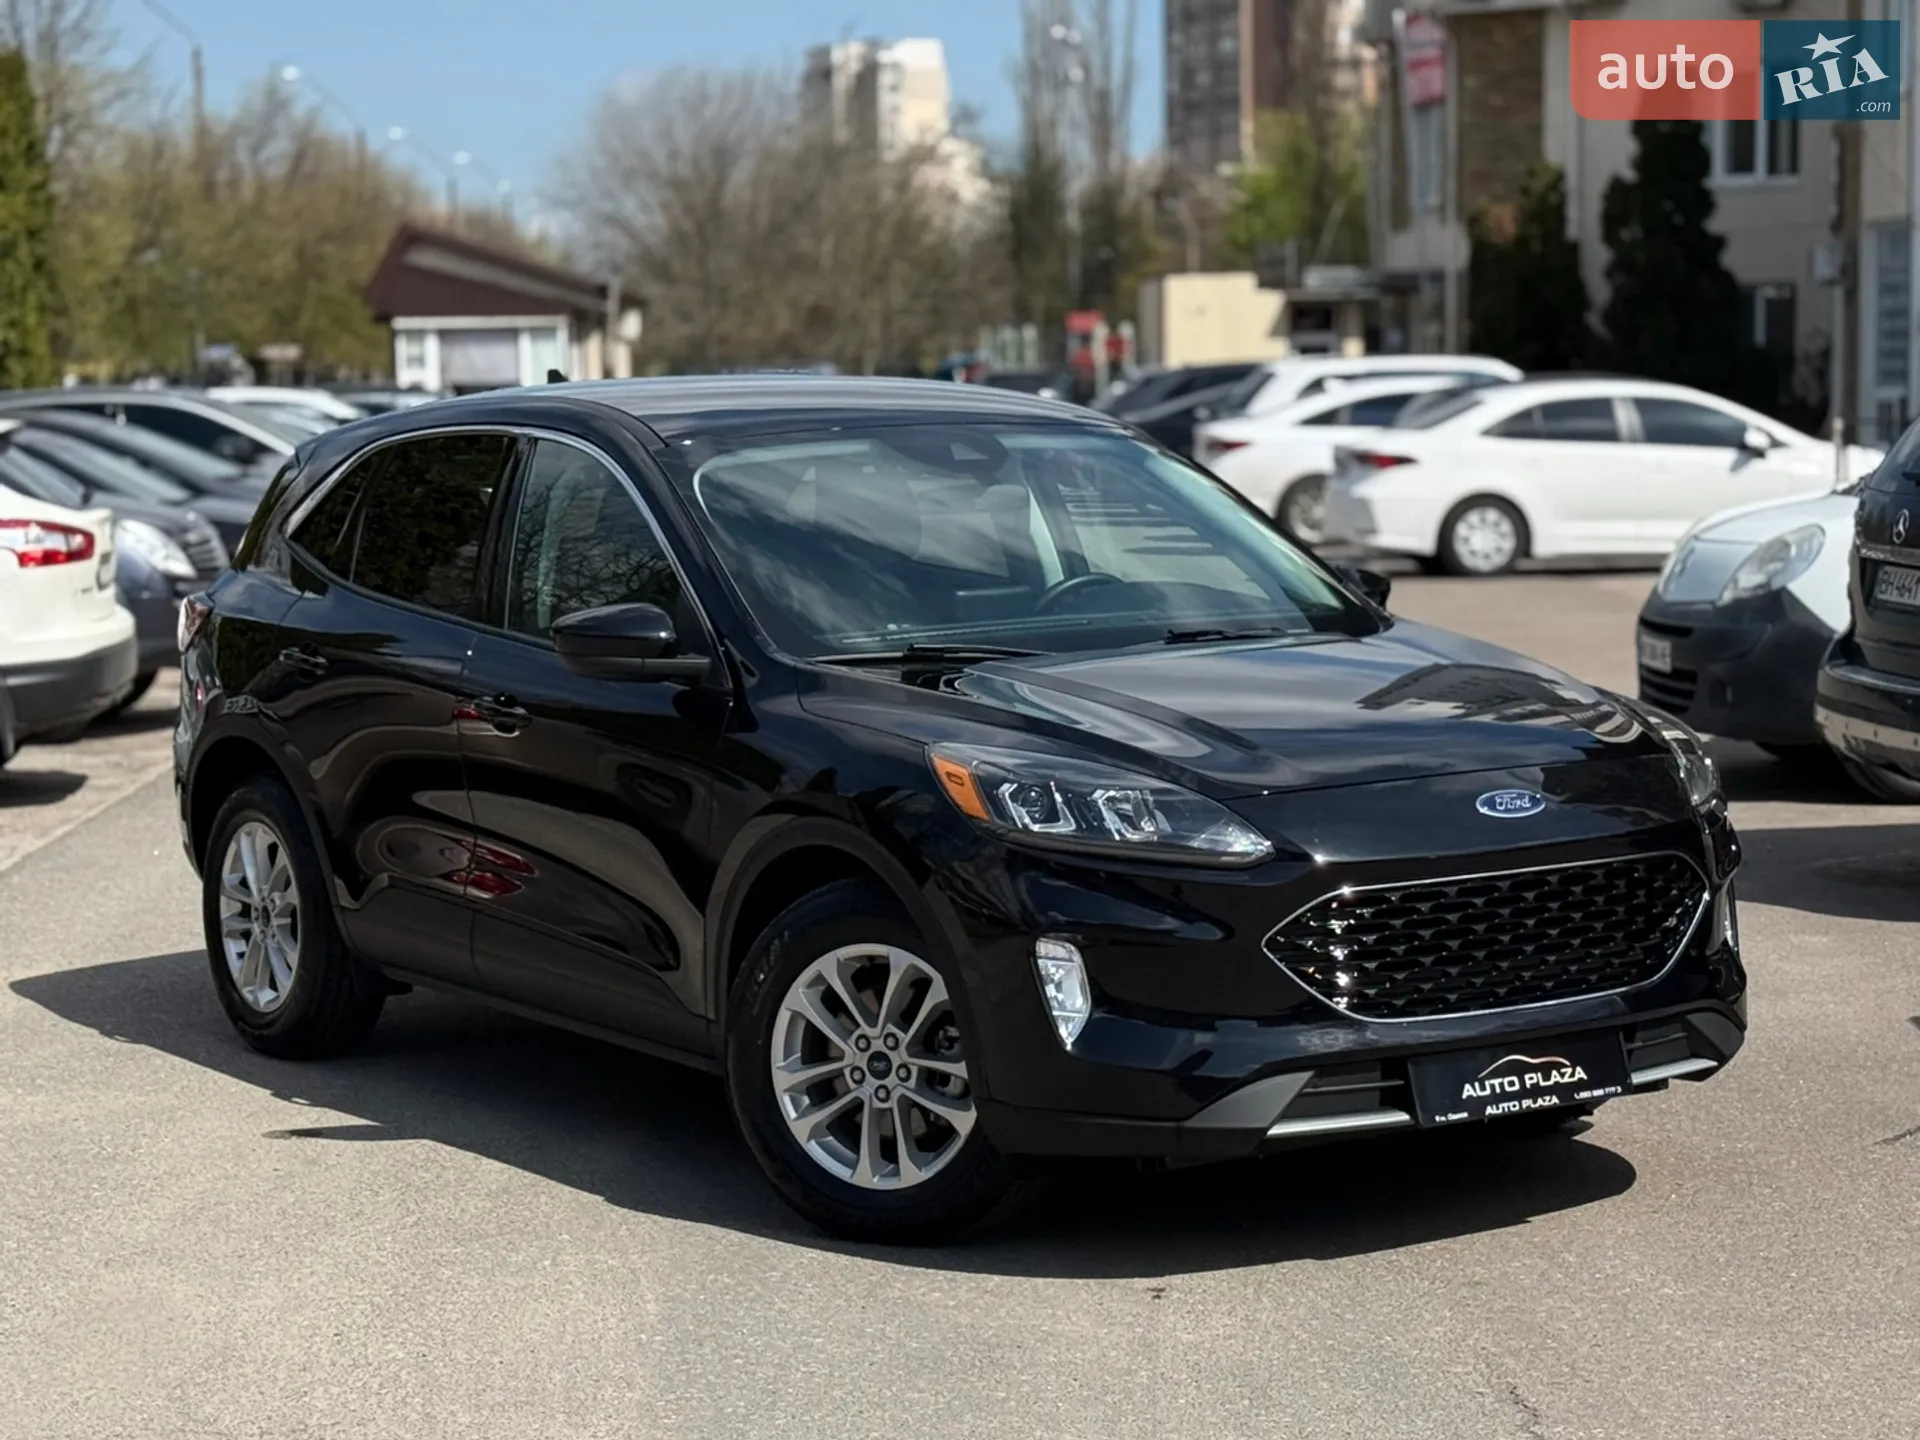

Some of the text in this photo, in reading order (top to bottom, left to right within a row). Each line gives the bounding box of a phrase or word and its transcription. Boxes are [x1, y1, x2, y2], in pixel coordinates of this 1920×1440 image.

[1495, 793, 1532, 810] Ford
[1462, 1066, 1588, 1099] AUTO PLAZA
[1485, 1095, 1560, 1115] AUTO PLAZA
